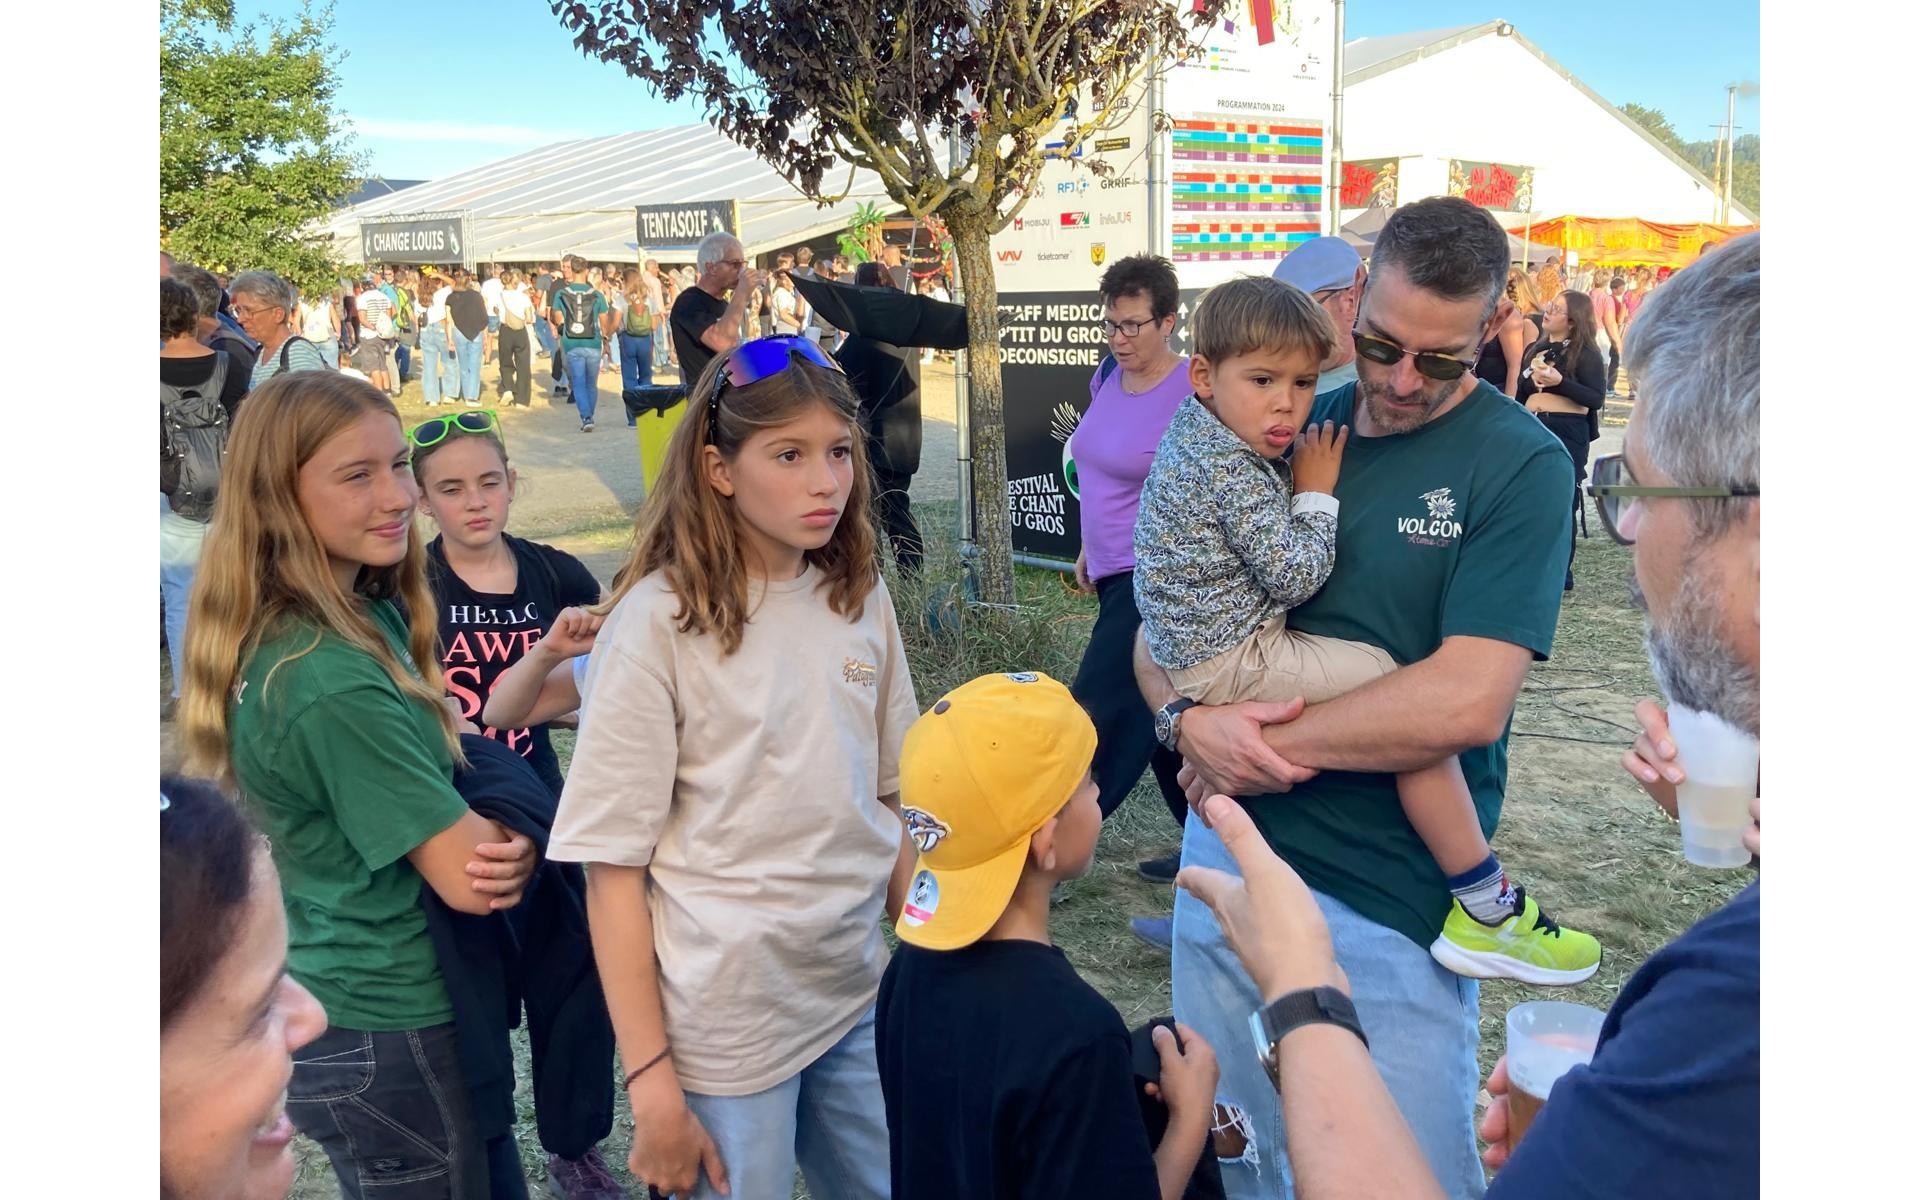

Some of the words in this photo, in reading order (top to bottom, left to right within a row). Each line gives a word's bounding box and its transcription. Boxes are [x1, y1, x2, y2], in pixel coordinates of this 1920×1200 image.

[1217, 99, 1271, 111] PROGRAMMATION
[1057, 183, 1075, 193] RFJ
[1101, 178, 1130, 190] GRRIF
[641, 209, 708, 238] TENTASOIF
[373, 231, 410, 252] CHANGE
[412, 230, 445, 251] LOUIS
[1046, 304, 1106, 322] MEDICA
[998, 326, 1036, 343] P'TIT
[1040, 326, 1062, 343] DU
[999, 347, 1100, 366] DECONSIGNE
[1008, 472, 1059, 495] ESTIVAL
[1008, 495, 1017, 511] E
[1020, 494, 1066, 515] CHANT
[1010, 511, 1022, 527] U
[1025, 513, 1065, 536] GROS
